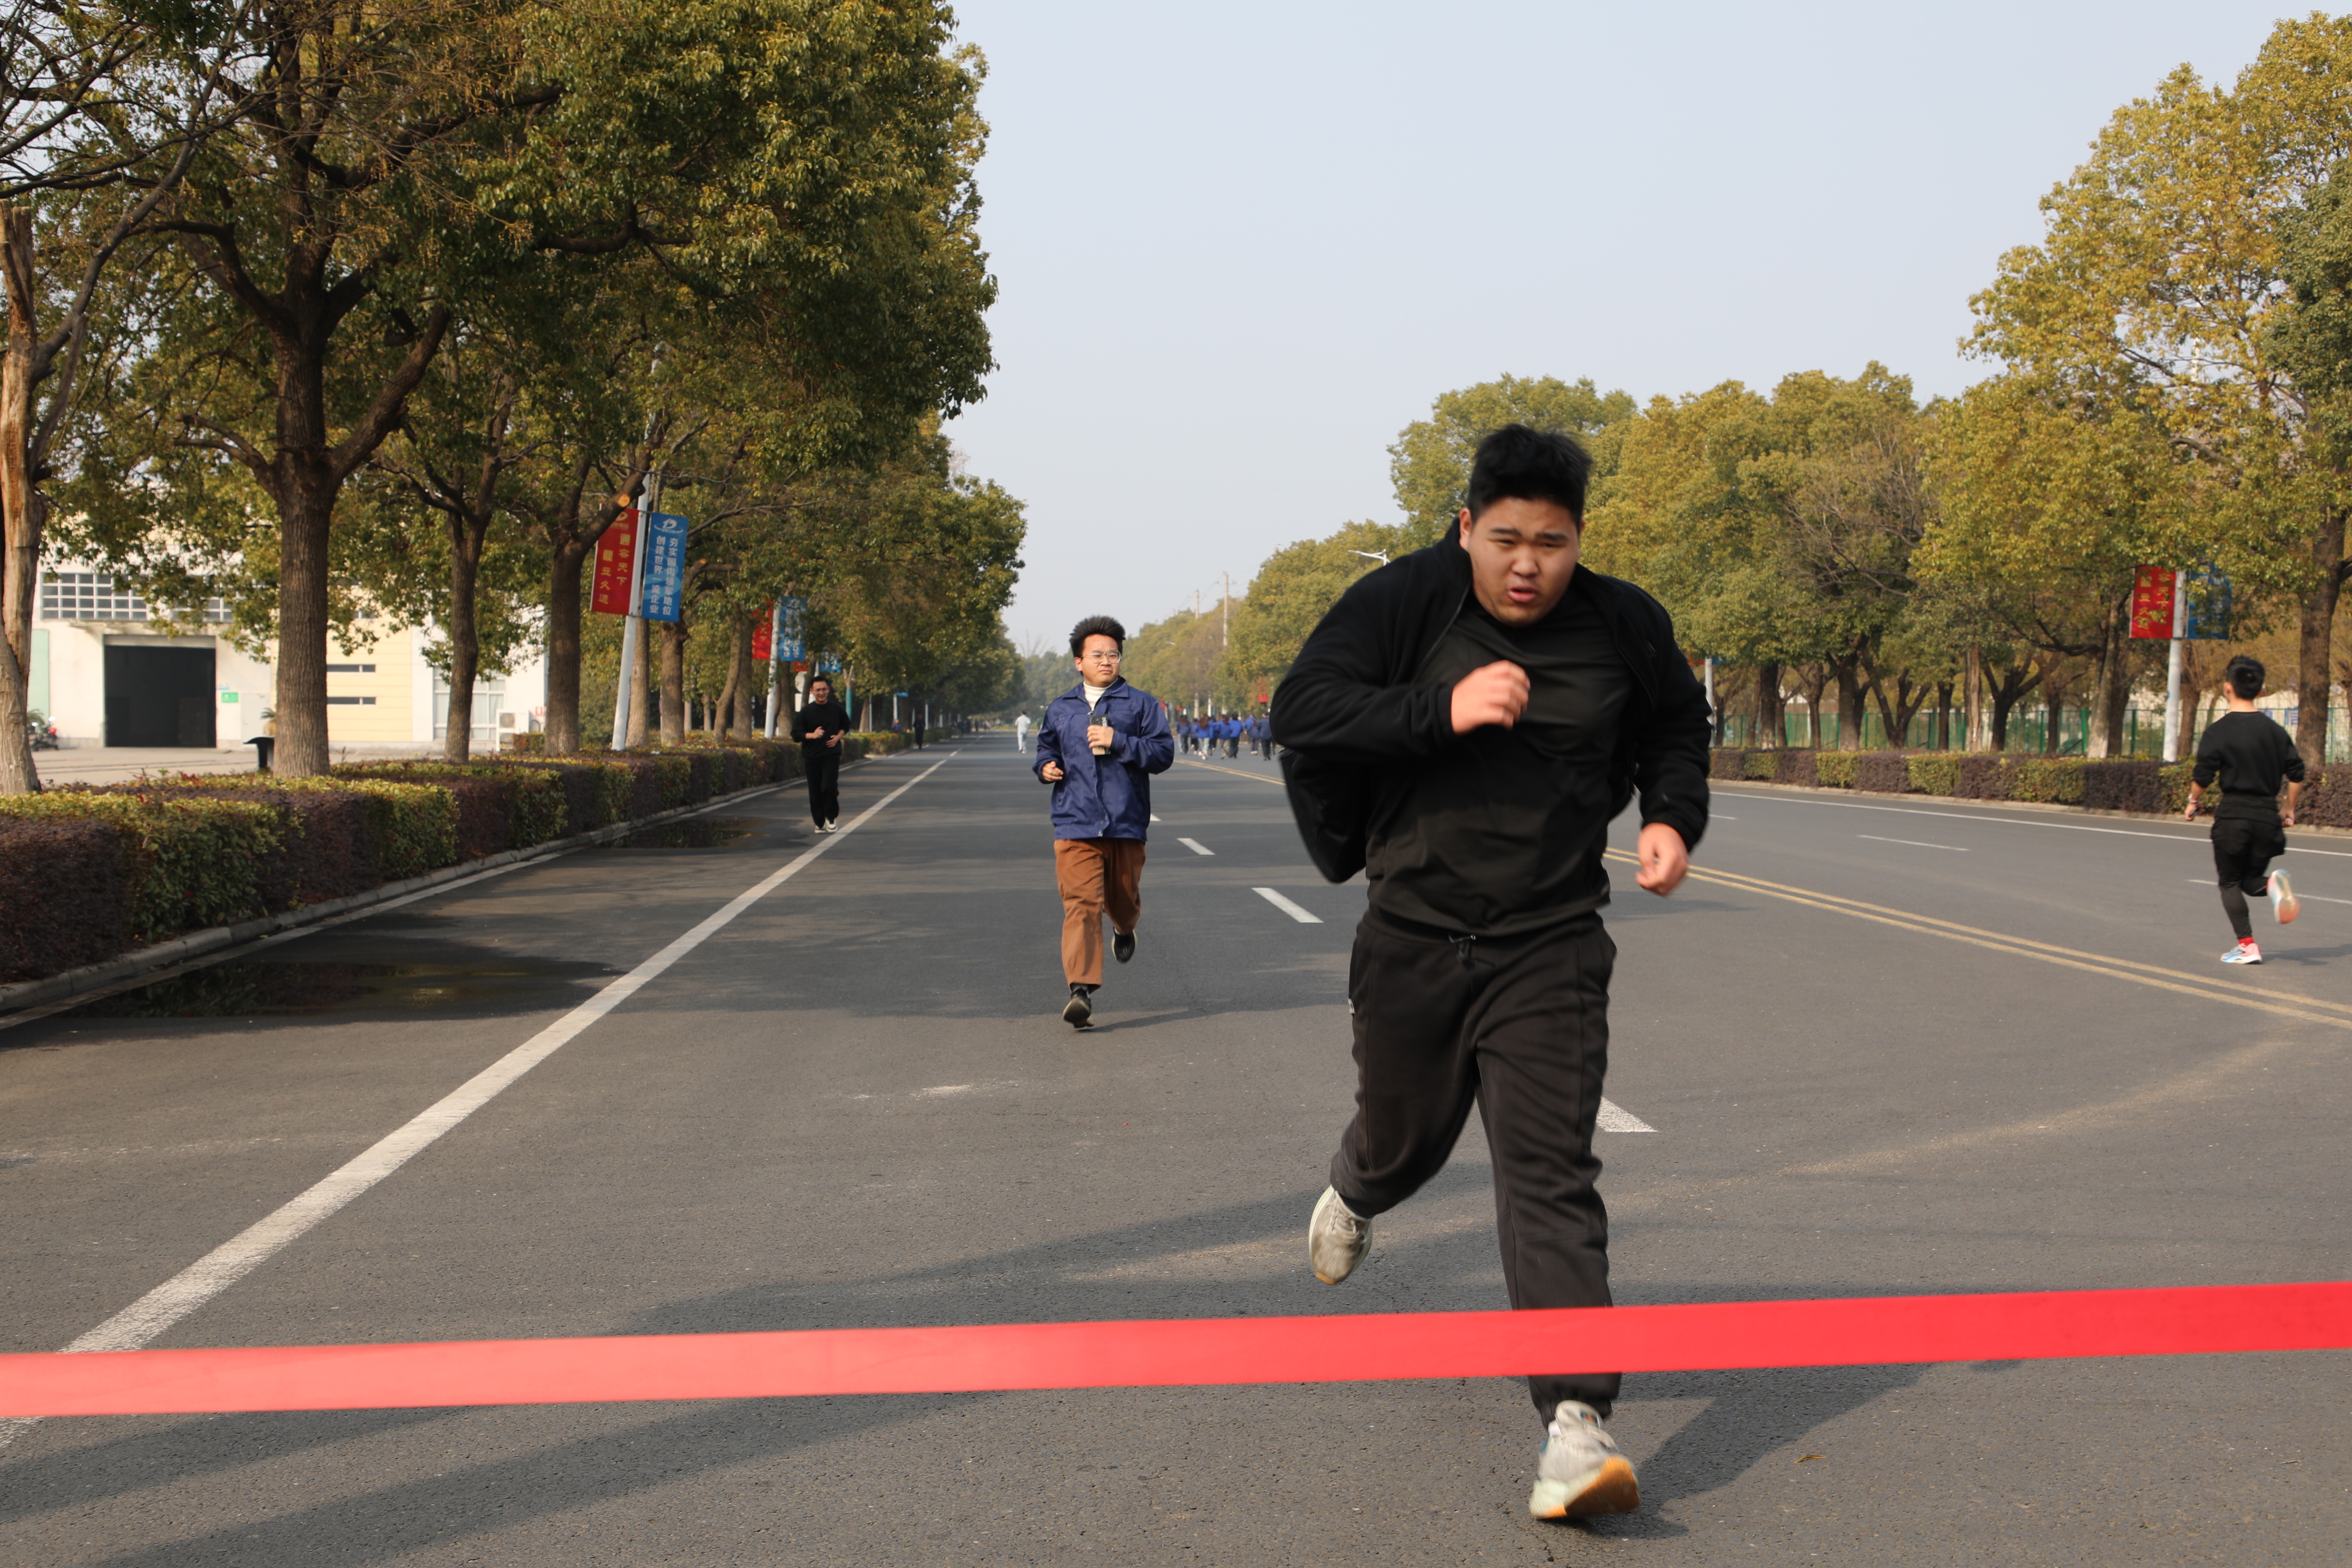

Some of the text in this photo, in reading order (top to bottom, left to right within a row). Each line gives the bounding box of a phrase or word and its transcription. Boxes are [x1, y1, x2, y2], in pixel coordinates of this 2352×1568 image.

[649, 535, 666, 614] 创建世界一流企业
[662, 538, 678, 615] 夯实国内领军地位
